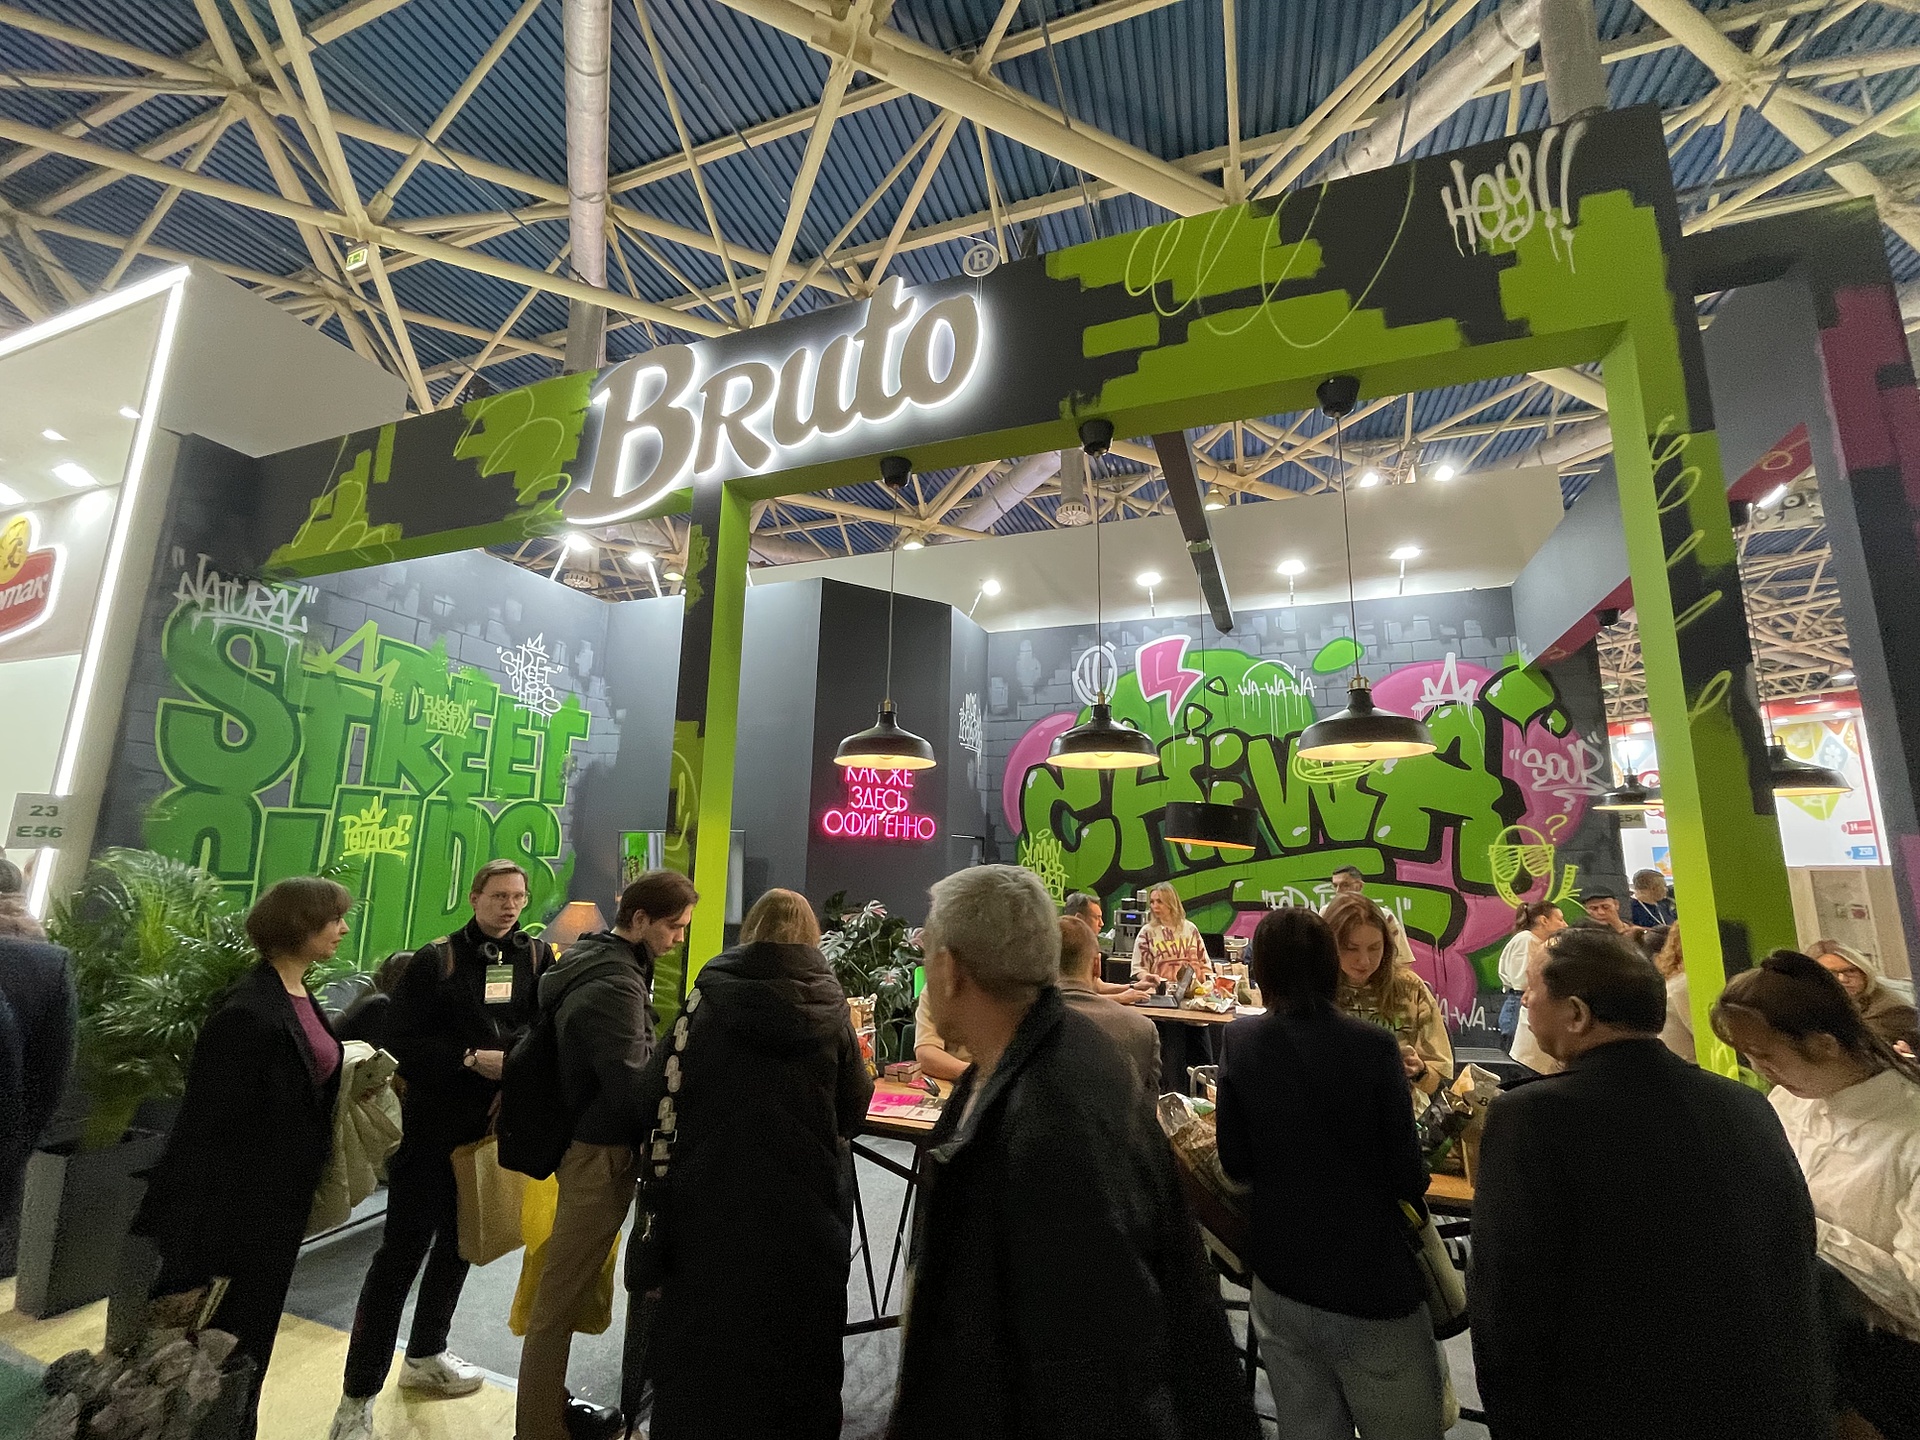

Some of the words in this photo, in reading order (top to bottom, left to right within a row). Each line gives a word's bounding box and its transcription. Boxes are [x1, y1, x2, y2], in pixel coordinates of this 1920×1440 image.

[160, 602, 591, 811] STREET
[845, 766, 881, 783] КАК
[886, 767, 914, 788] ЖЕ
[29, 805, 59, 817] 23
[850, 786, 908, 812] ЗДЕСЬ
[16, 825, 64, 838] E56
[824, 811, 936, 840] ОФИГЕННО
